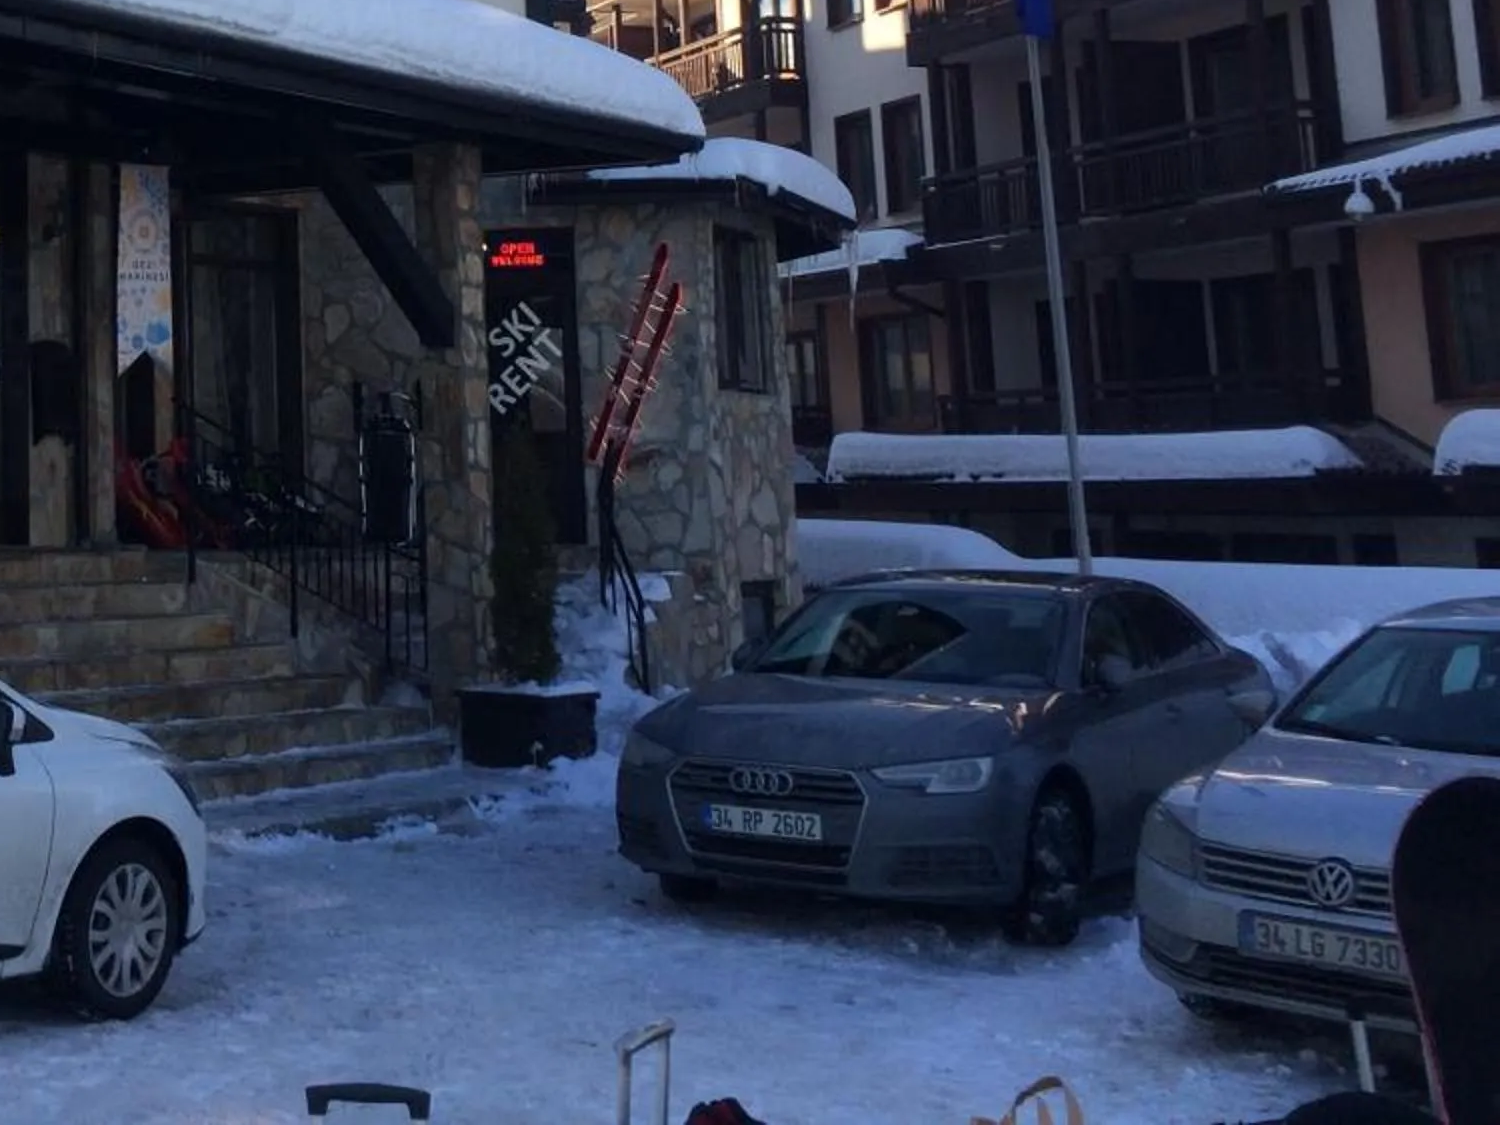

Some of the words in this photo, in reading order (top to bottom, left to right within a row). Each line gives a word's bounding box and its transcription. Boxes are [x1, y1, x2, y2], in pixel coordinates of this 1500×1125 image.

[489, 302, 542, 358] SKI
[488, 327, 563, 416] RENT
[711, 807, 734, 828] 34
[741, 809, 764, 832] RP
[771, 811, 818, 838] 2602
[1257, 923, 1287, 953] 34
[1293, 927, 1326, 959] LG
[1337, 936, 1401, 971] 7330
